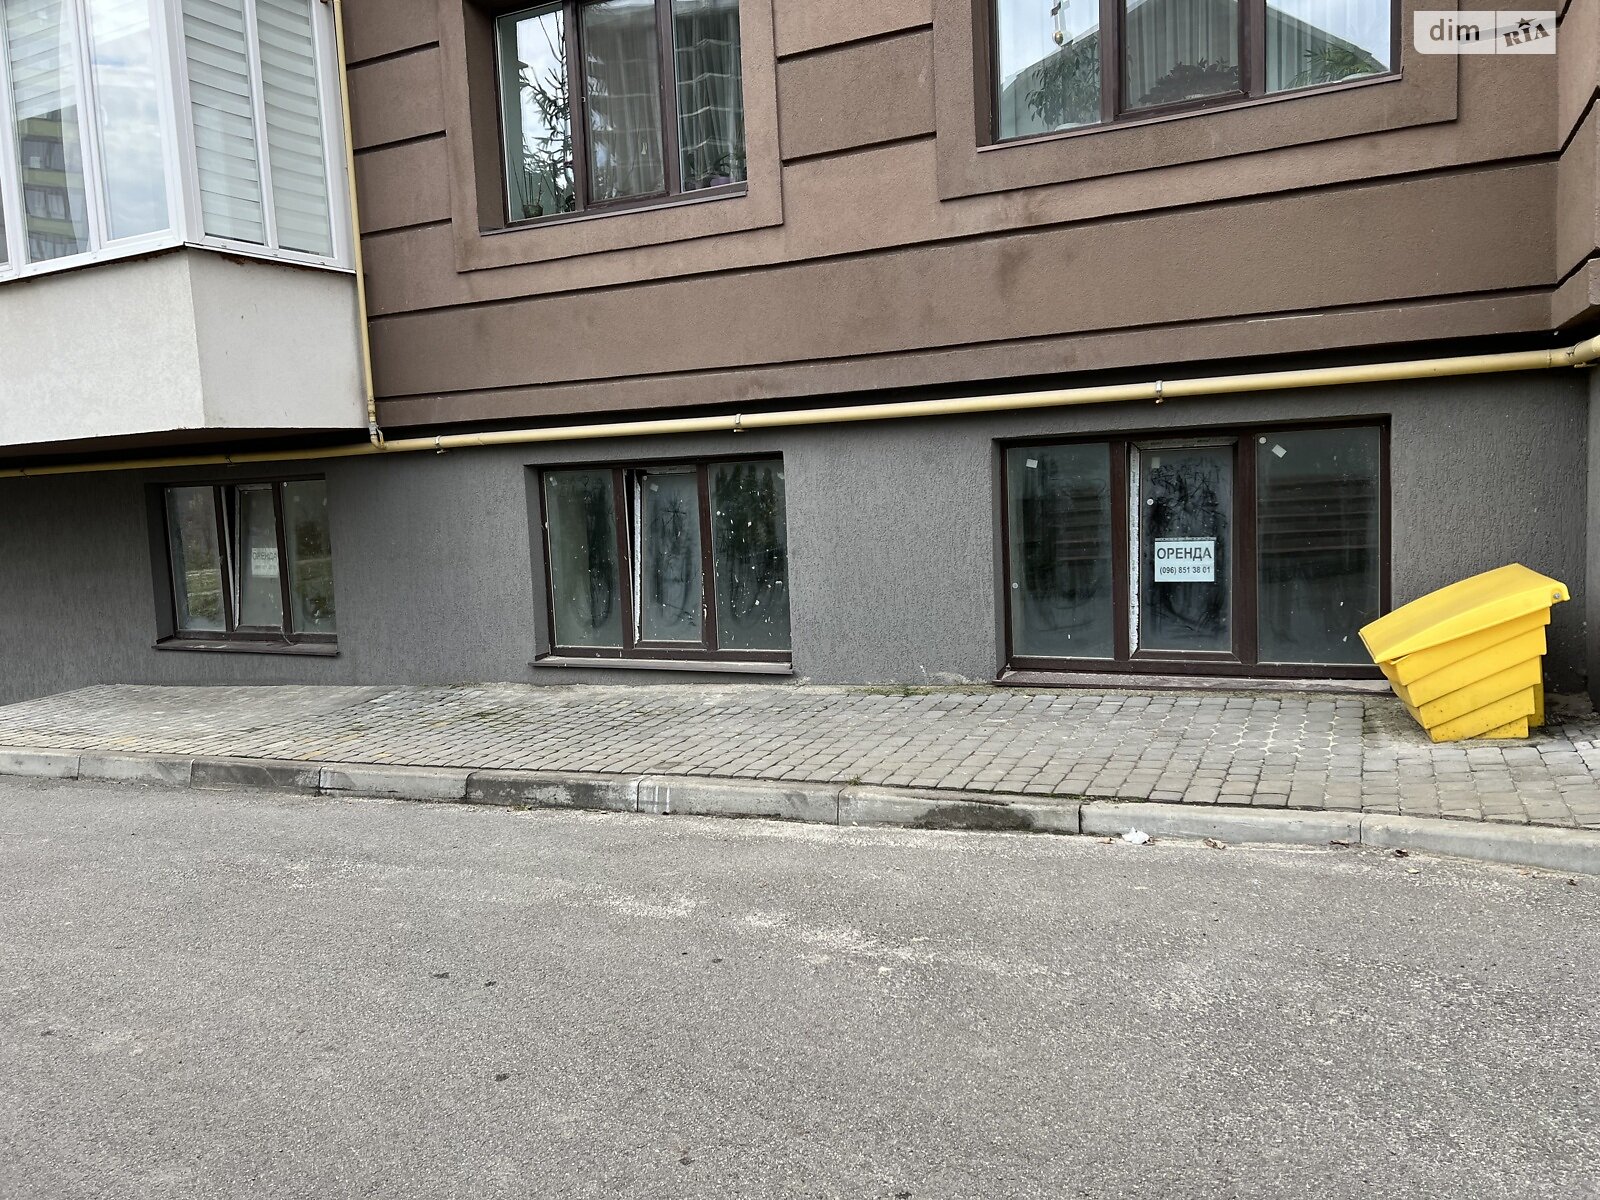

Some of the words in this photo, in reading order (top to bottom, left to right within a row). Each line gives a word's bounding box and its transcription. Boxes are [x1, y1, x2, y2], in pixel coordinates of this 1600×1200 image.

[1156, 547, 1213, 562] ОРЕНДА
[1159, 566, 1177, 575] (096)
[1178, 566, 1190, 574] 851
[1192, 566, 1201, 574] 38
[1202, 566, 1211, 574] 01
